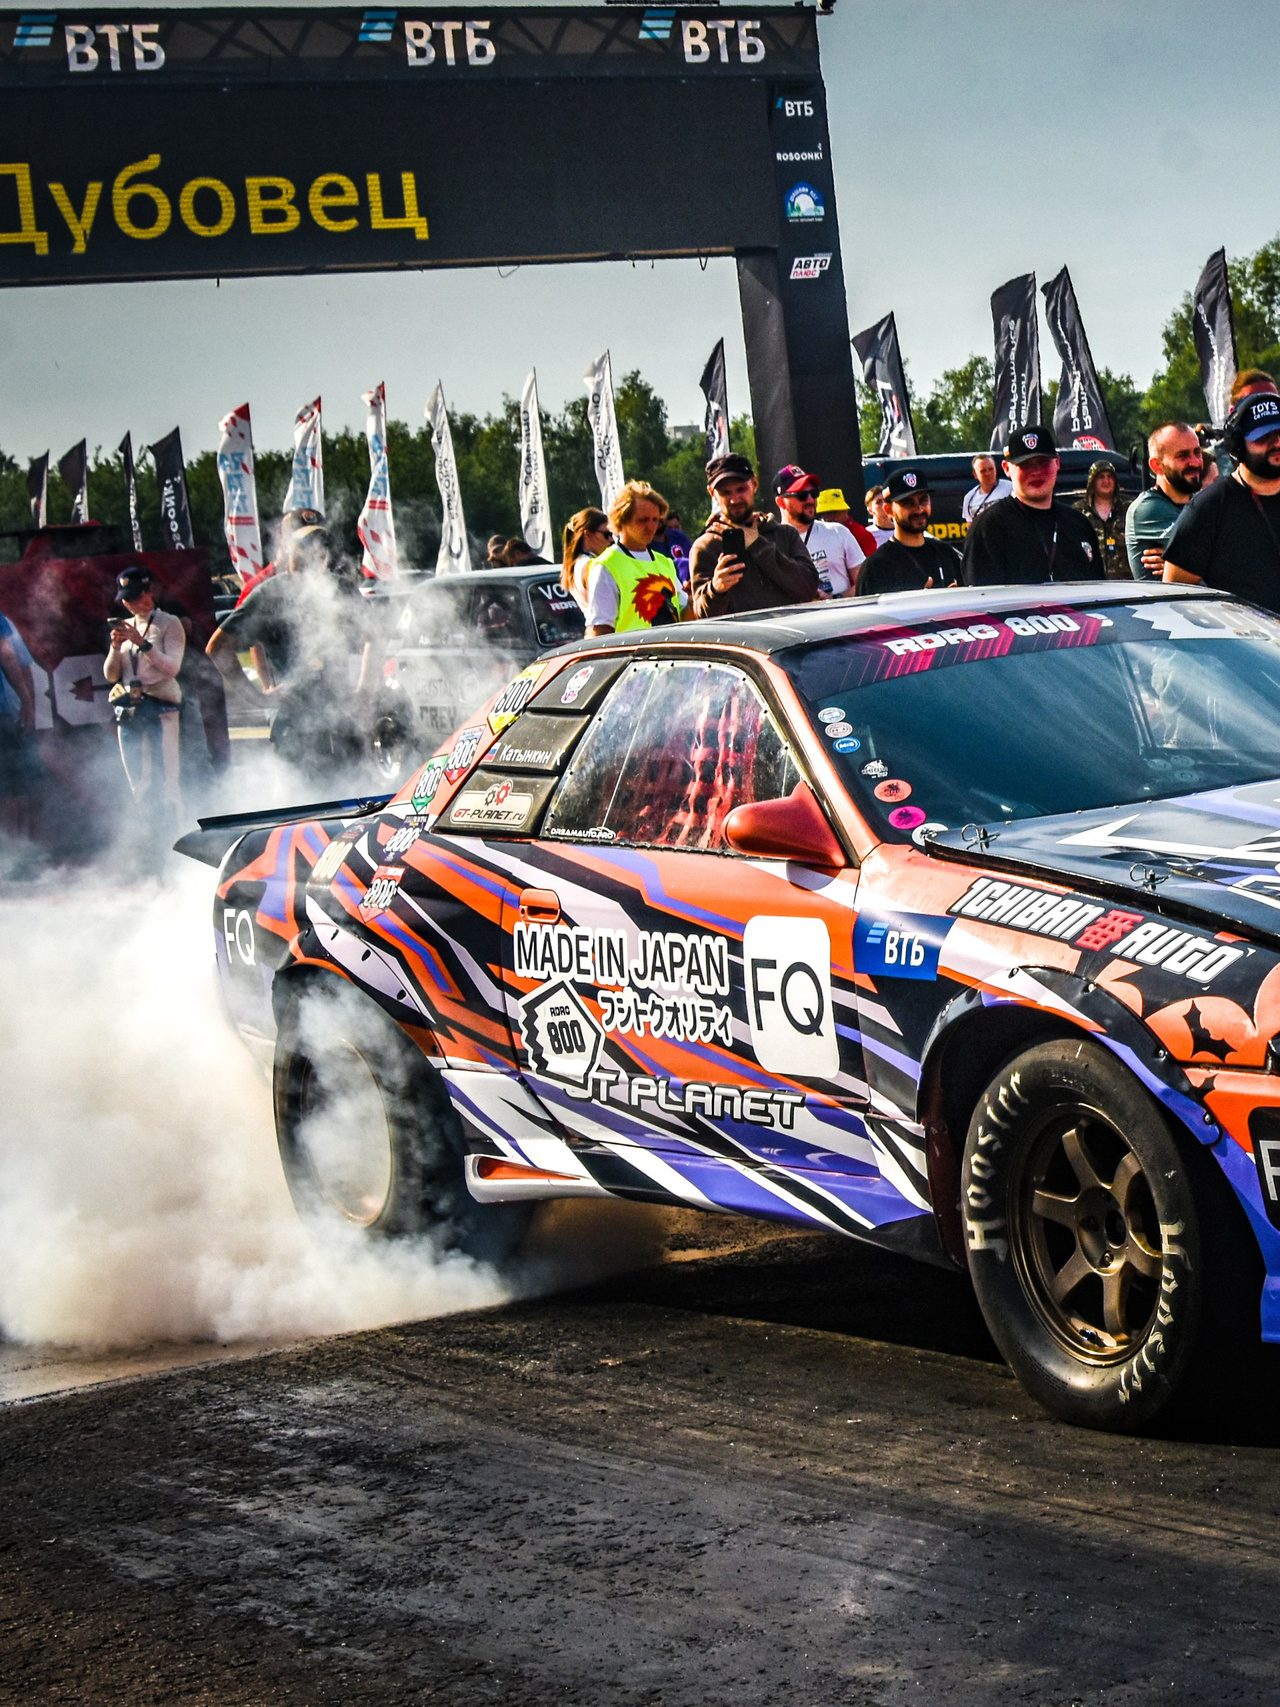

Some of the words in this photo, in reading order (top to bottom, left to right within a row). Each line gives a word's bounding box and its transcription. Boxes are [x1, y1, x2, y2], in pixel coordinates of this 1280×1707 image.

[65, 23, 166, 72] ВТБ
[404, 20, 497, 67] ВТБ
[682, 19, 767, 65] ВТБ
[784, 100, 815, 118] ВТБ
[0, 154, 430, 256] Дубовец
[794, 258, 829, 269] АВТО
[1250, 401, 1278, 417] TOYS
[882, 623, 1001, 657] RDRC
[1003, 613, 1081, 638] 800
[500, 744, 552, 765] Катынкин
[222, 907, 257, 967] FQ
[516, 928, 593, 977] MADE
[598, 936, 626, 980] IN
[633, 934, 727, 989] JAPAN
[884, 930, 926, 968] ВТБ
[549, 1005, 571, 1017] RDRC
[750, 958, 825, 1037] FQ
[546, 1019, 587, 1055] 800
[630, 1077, 806, 1128] PLANET
